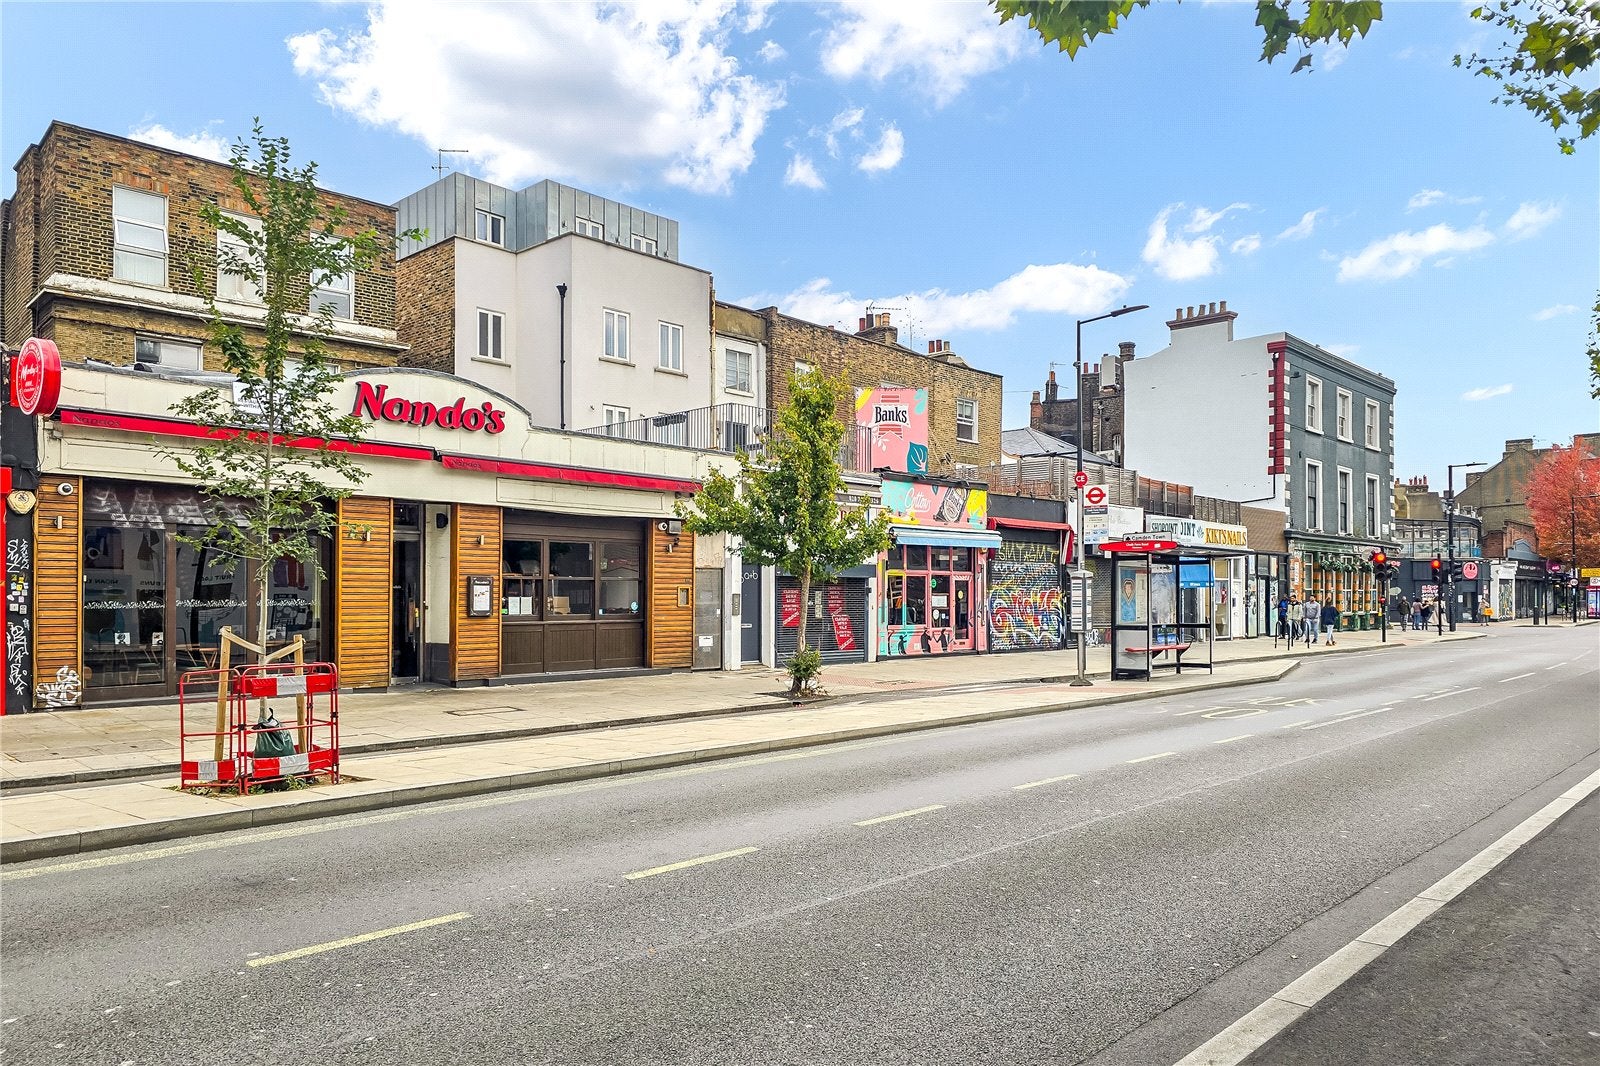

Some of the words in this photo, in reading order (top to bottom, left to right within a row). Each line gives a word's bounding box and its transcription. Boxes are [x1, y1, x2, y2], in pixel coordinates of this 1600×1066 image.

[351, 381, 505, 434] Nando's
[875, 406, 908, 424] Banks
[1227, 529, 1246, 546] NAILS
